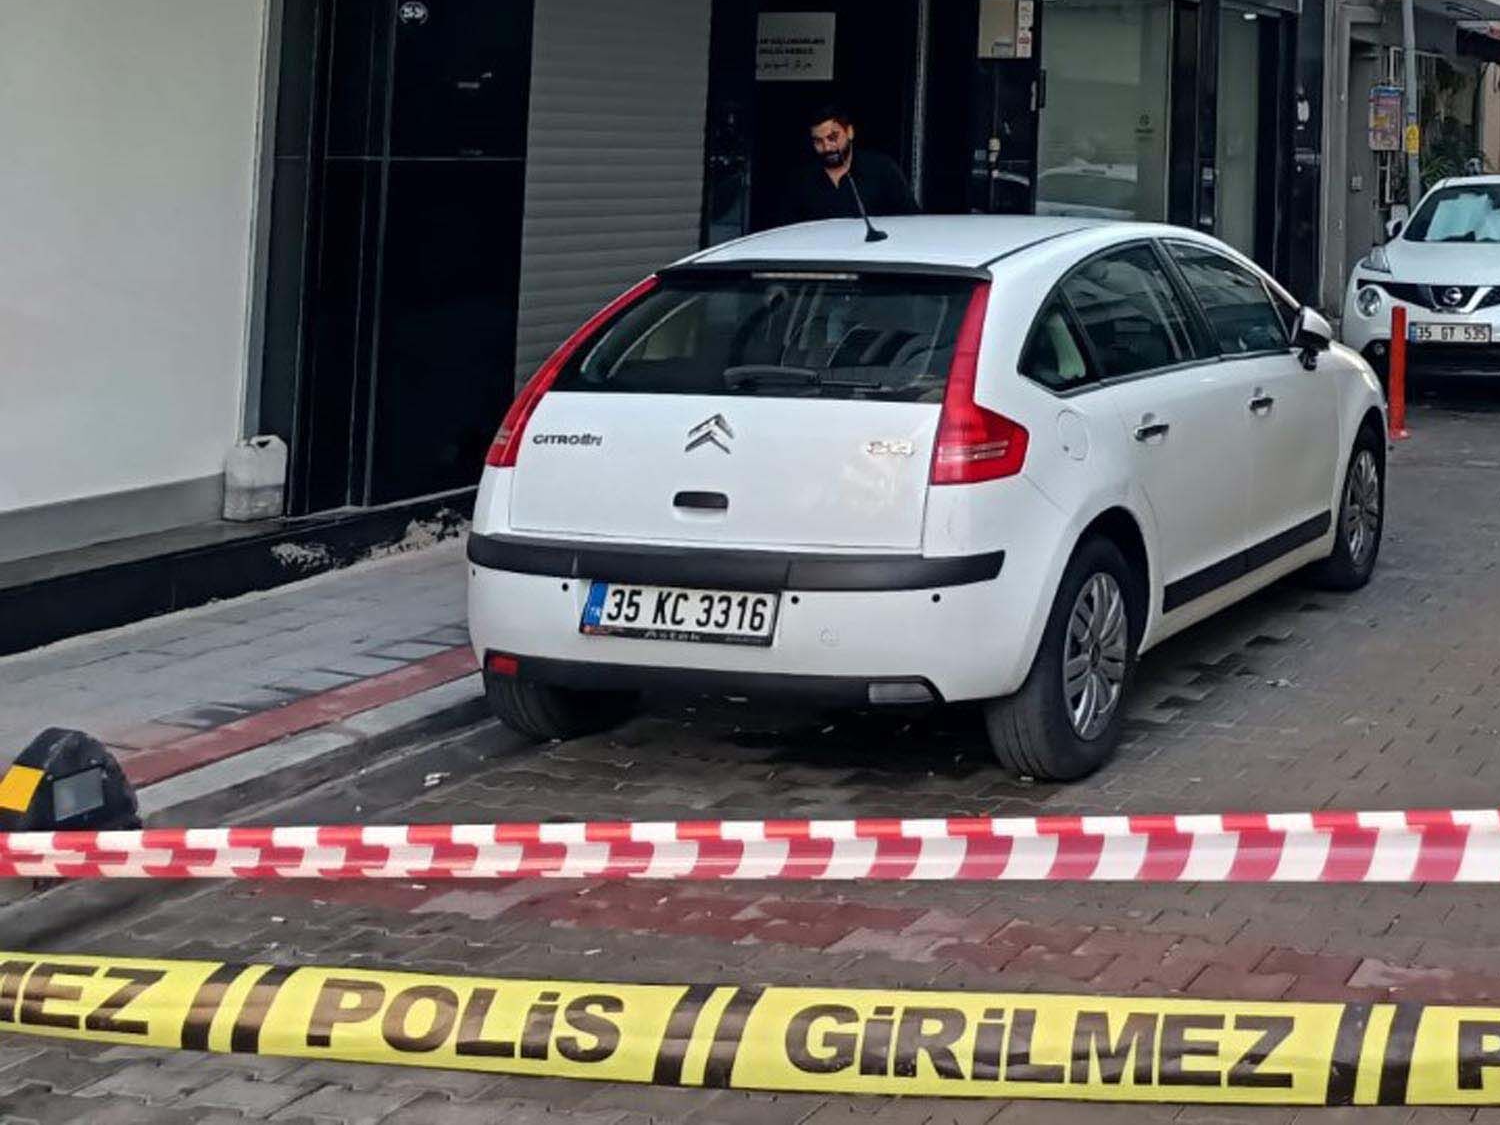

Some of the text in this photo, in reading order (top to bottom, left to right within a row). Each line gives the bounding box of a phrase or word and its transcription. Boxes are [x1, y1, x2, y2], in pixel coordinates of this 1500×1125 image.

[606, 588, 768, 632] 35 KC 3316
